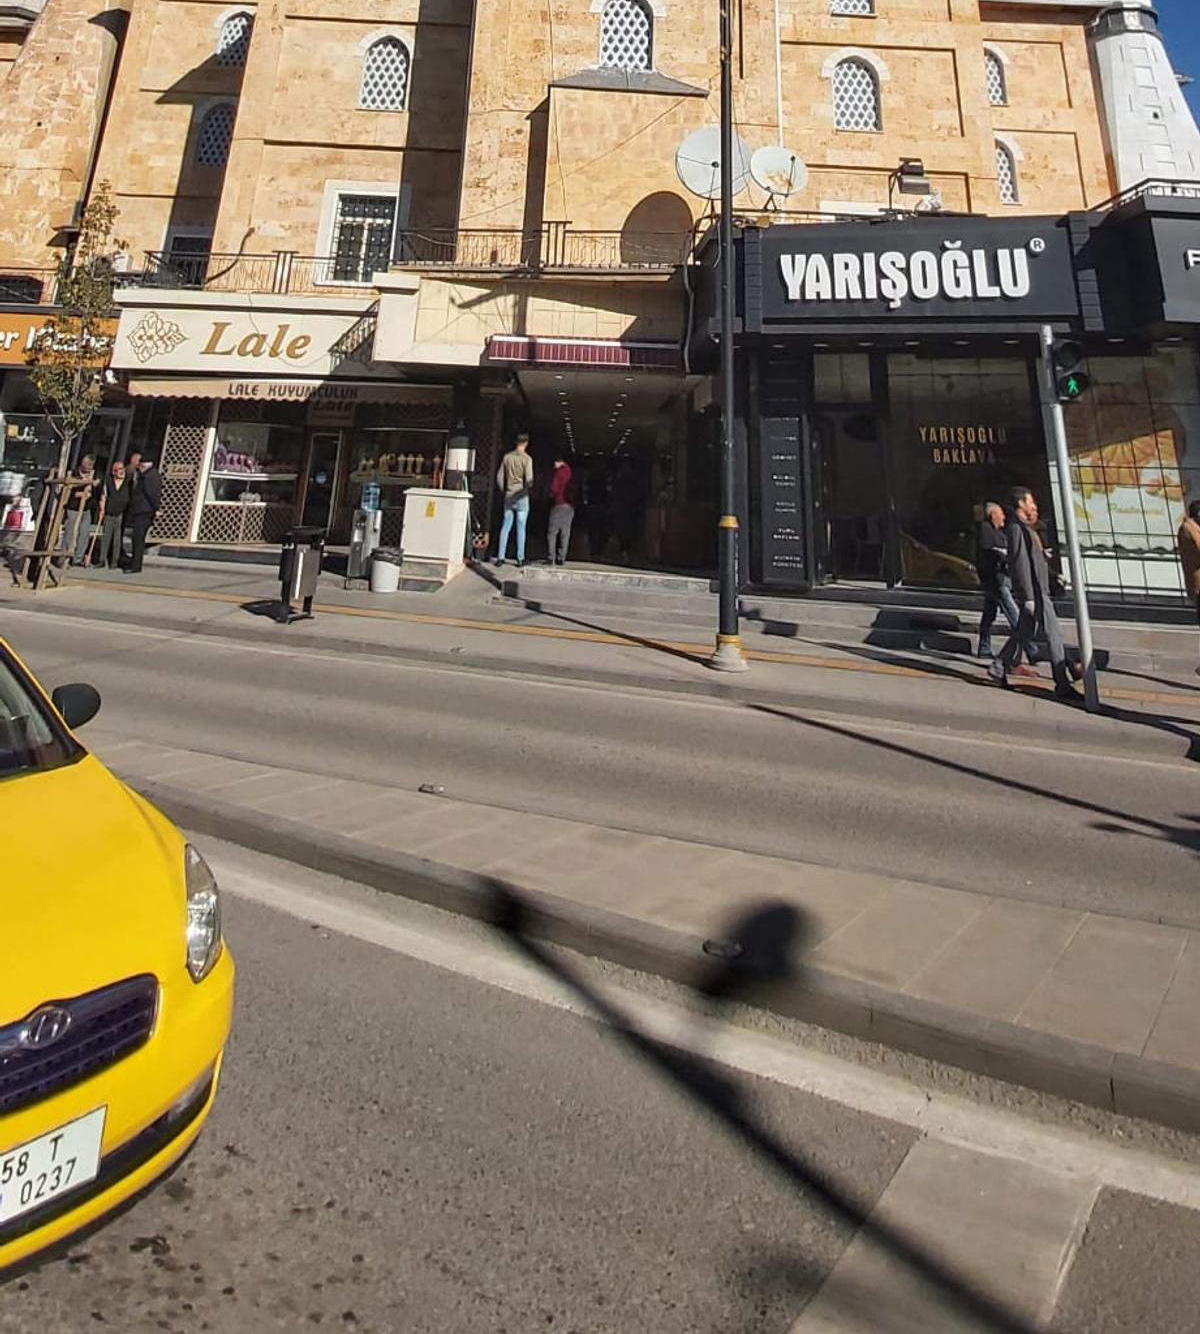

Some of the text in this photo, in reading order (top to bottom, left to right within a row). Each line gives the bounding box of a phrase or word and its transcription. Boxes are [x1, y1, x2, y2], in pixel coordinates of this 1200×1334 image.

[780, 240, 1030, 309] YARIŞOĞLU
[199, 322, 312, 359] Lale
[228, 383, 259, 397] LALE
[933, 448, 996, 464] BAKLAVA
[1, 1133, 64, 1184] 58 T
[20, 1156, 77, 1205] 0237
